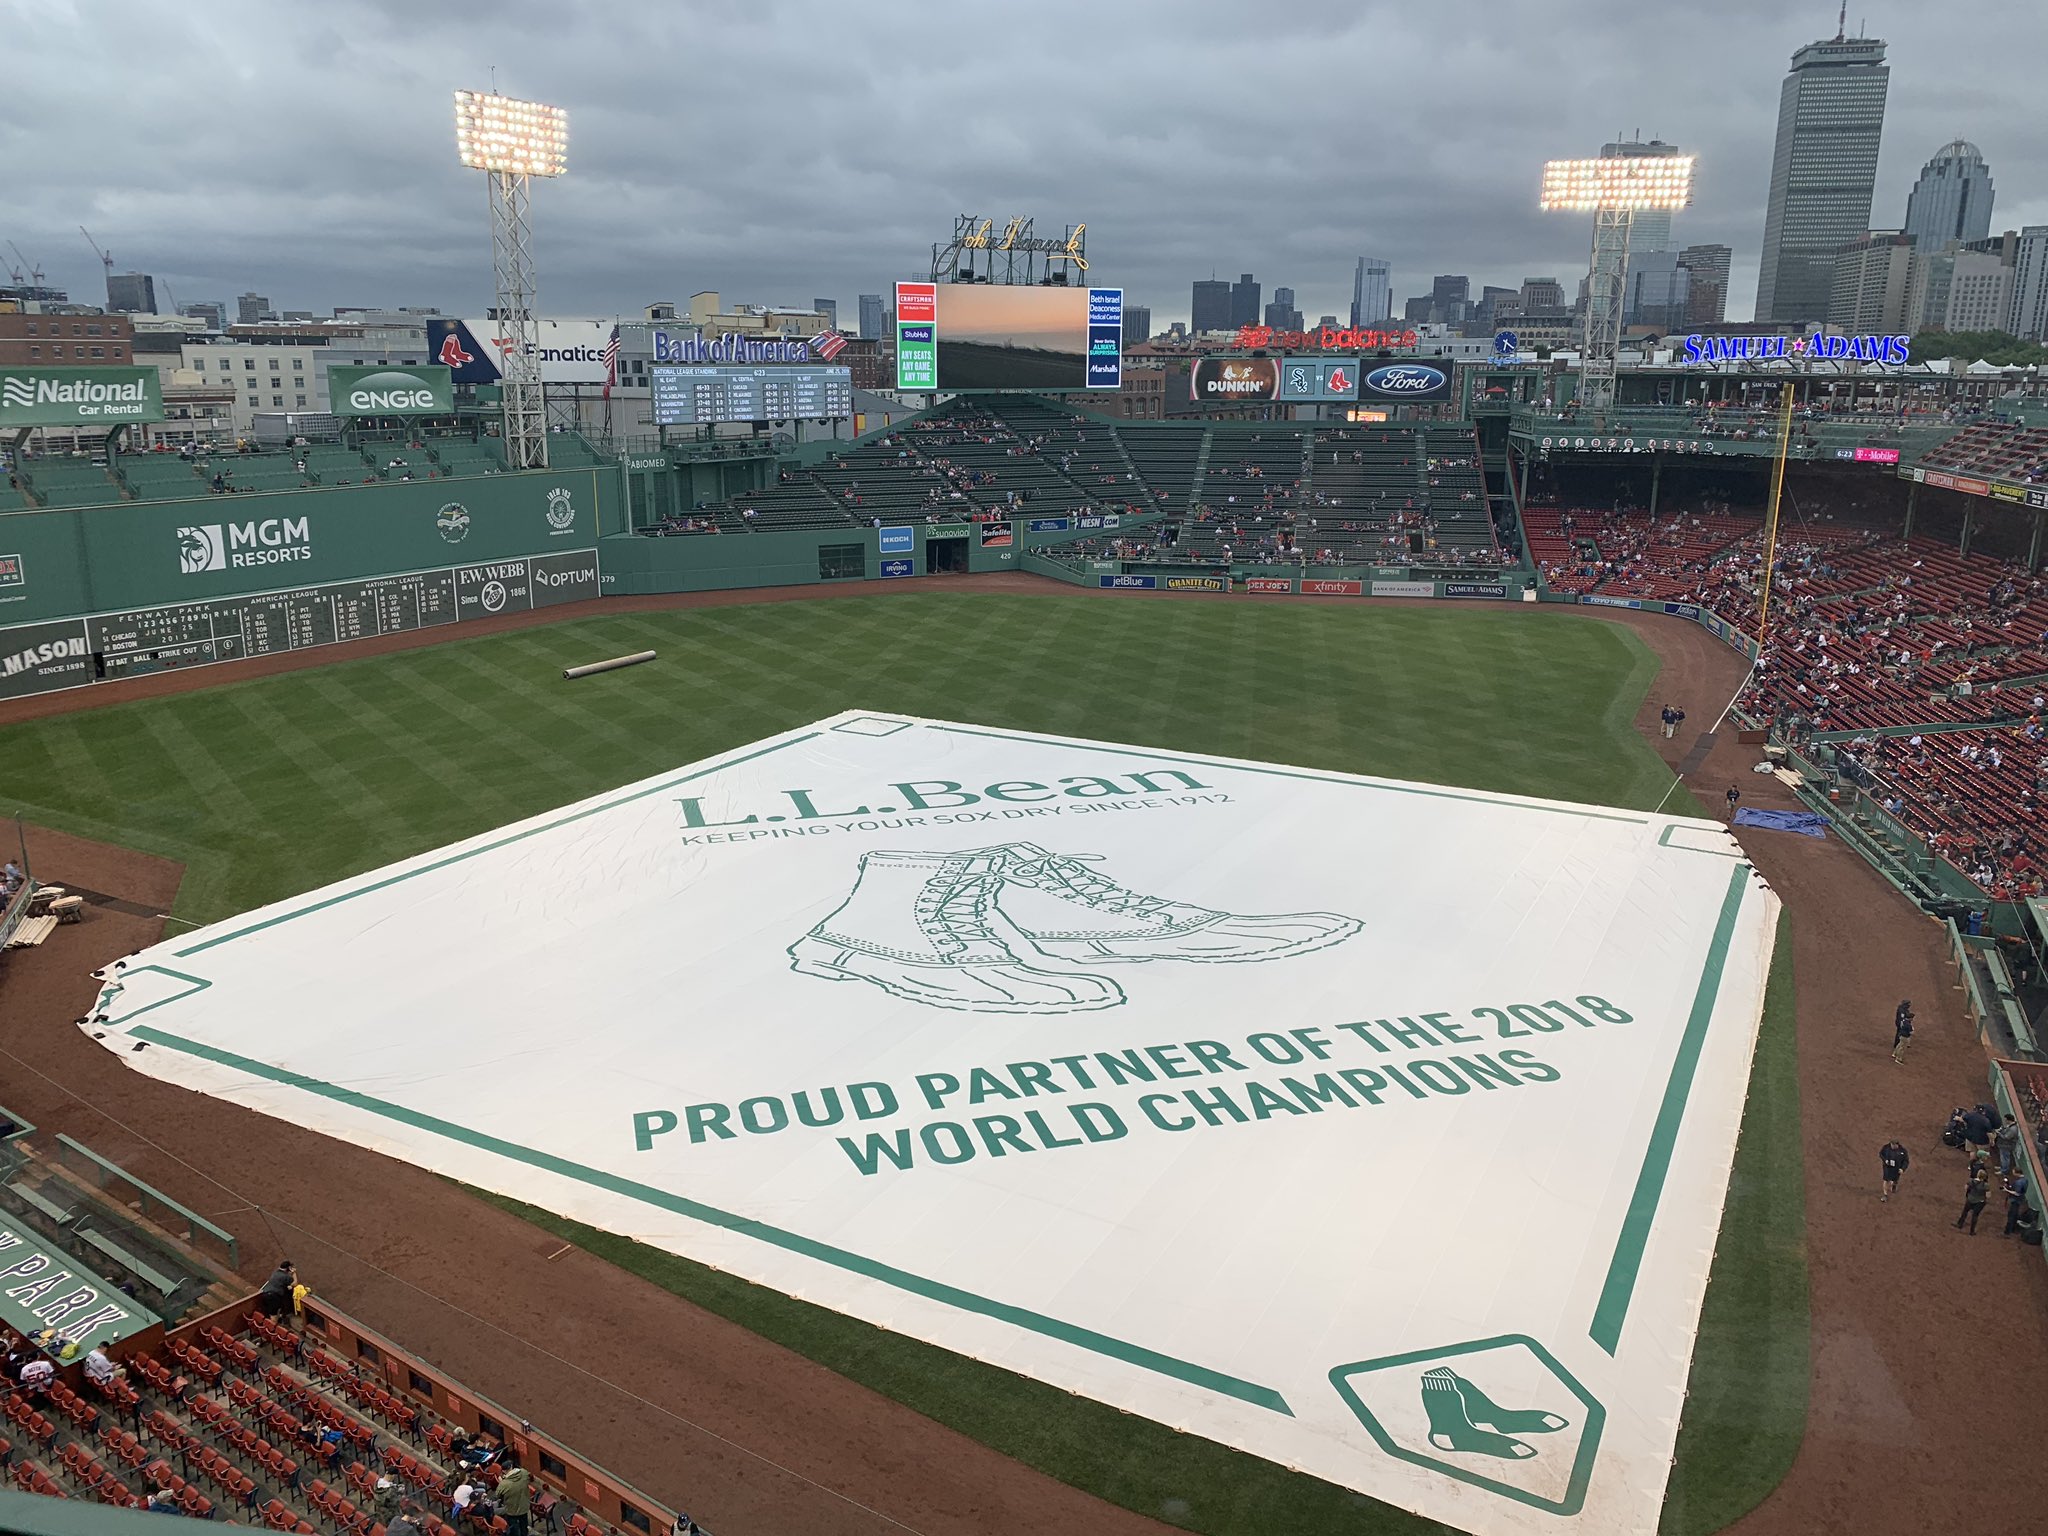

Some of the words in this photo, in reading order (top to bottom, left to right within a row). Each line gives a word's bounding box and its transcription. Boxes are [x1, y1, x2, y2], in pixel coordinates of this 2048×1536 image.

[934, 213, 998, 276] John
[998, 215, 1089, 270] Hancock
[1091, 295, 1104, 303] Beth
[1105, 295, 1120, 304] Israel
[1090, 304, 1120, 312] Deaconess
[1274, 330, 1318, 348] new
[1321, 325, 1419, 348] balance
[653, 331, 709, 361] Bank
[709, 333, 731, 361] of
[732, 335, 808, 362] America
[1683, 333, 1792, 364] SAMUEL
[1804, 331, 1910, 364] ADAMS
[524, 344, 606, 362] Fanatics
[901, 350, 912, 360] ANY
[902, 361, 913, 370] ANY
[1090, 364, 1118, 372] Marshalls
[904, 372, 915, 381] ANY
[917, 372, 930, 381] TIME
[1380, 370, 1430, 391] Ford
[37, 378, 145, 403] National
[1207, 380, 1264, 392] DUNKIN'
[78, 405, 100, 415] Car
[104, 404, 142, 414] Rental
[630, 458, 665, 469] ABIOMED
[1080, 517, 1101, 528] NESN
[228, 516, 310, 549] MGM
[936, 528, 969, 538] sunovion
[232, 546, 311, 567] RESORTS
[485, 563, 524, 580] WEBB
[550, 568, 594, 587] OPTUM
[366, 579, 396, 588] NATIONAL
[1112, 577, 1143, 587] jetBlue
[1168, 578, 1203, 588] GRANITE
[1204, 579, 1222, 589] CITY
[1266, 581, 1288, 589] JOE'S
[1314, 582, 1347, 592] xfinity
[251, 594, 288, 604] AMERICAN
[291, 590, 319, 599] LEAGUE
[461, 595, 478, 604] Since
[119, 610, 169, 622] FENWAY
[179, 604, 210, 614] PARK
[111, 632, 136, 641] CHICAGO
[146, 627, 172, 636] JUNE
[162, 634, 188, 643] 2019
[113, 641, 137, 650] BOSTON
[133, 654, 151, 663] BALL
[158, 649, 181, 659] STRIKE
[38, 664, 65, 675] SINCE
[66, 662, 85, 670] 1898
[673, 769, 1213, 829] L.L.Bean
[682, 823, 830, 846] KEEPING
[835, 817, 928, 833] YOUR
[935, 810, 999, 827] SOX
[1001, 805, 1064, 821] DRY
[1065, 798, 1165, 816] SINCE
[1165, 793, 1236, 808] 1912
[634, 1082, 898, 1152] PROUD
[916, 1041, 1247, 1110] PARTNER
[1248, 1028, 1330, 1064] OF
[1339, 1014, 1480, 1053] THE
[1472, 996, 1633, 1037] 2018
[838, 1102, 1129, 1176] WORLD
[1139, 1050, 1559, 1132] CHAMPIONS
[0, 1253, 129, 1344] PARK
